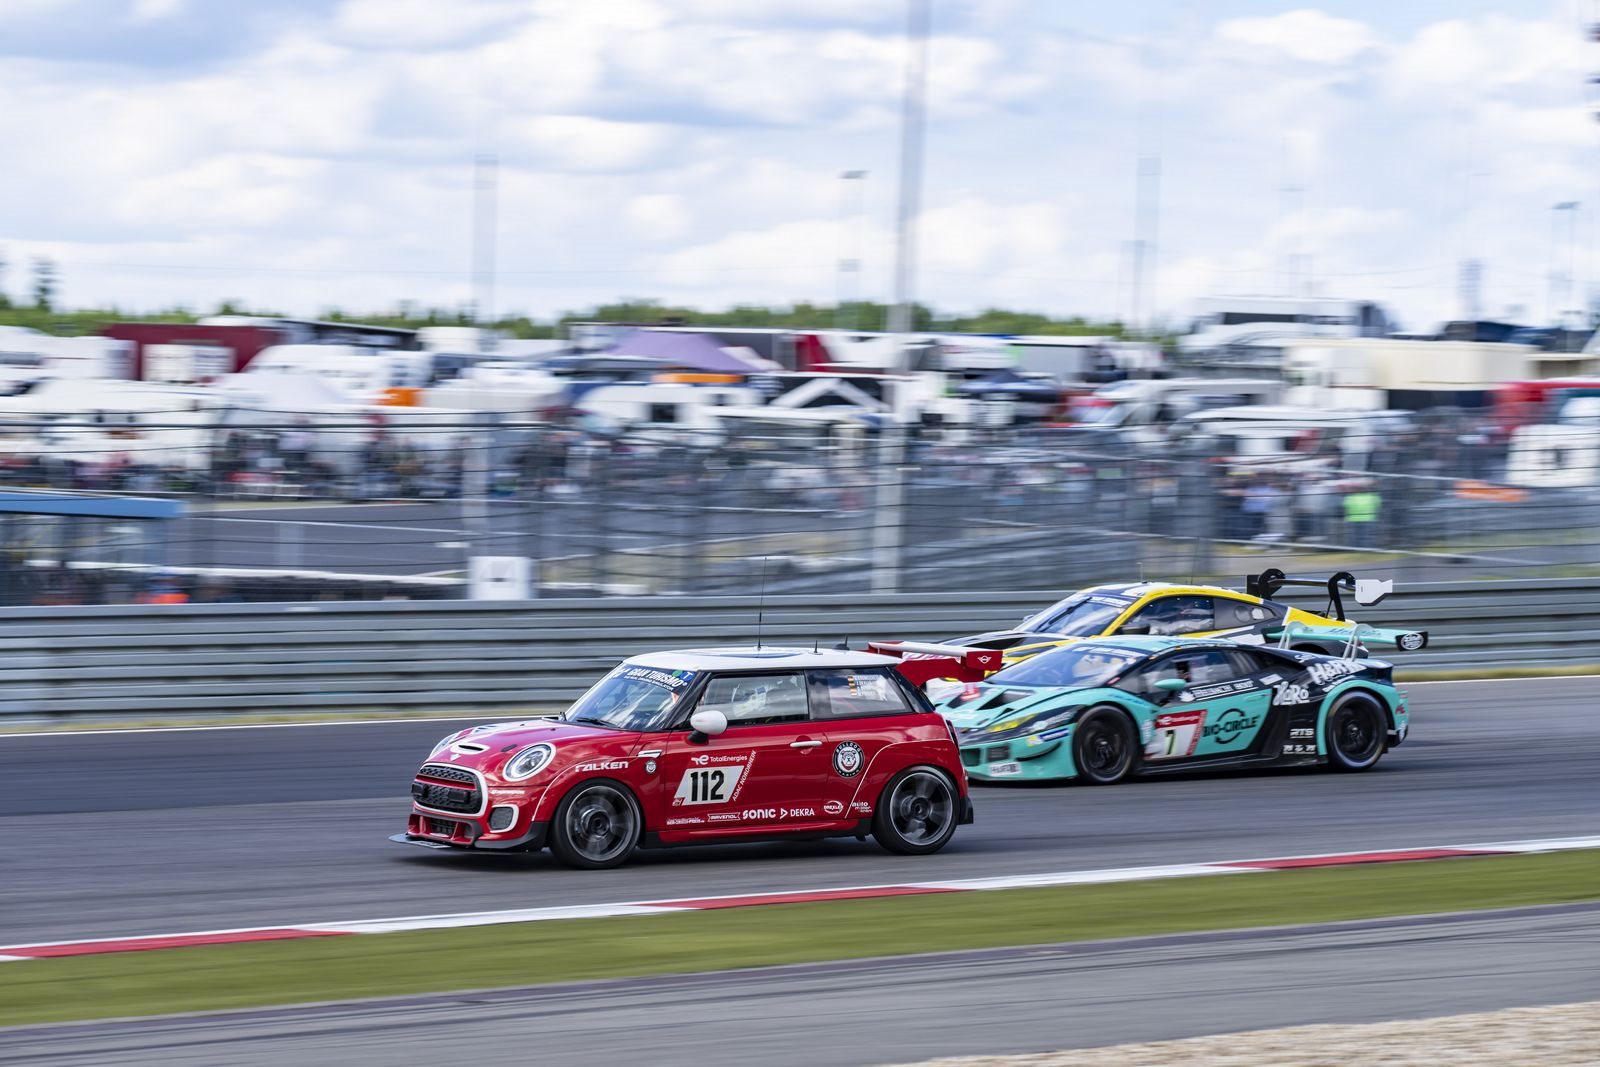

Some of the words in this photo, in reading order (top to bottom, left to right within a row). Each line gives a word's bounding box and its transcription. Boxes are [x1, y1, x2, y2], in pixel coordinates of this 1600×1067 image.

[646, 670, 684, 687] TURISMO
[1202, 715, 1259, 737] BIO-CIRCLE
[1166, 729, 1175, 755] 7
[575, 761, 629, 773] FALKEN
[710, 755, 748, 763] TotalEnergies
[732, 784, 743, 801] ADAC
[740, 749, 757, 785] NORDRHEIN
[690, 770, 725, 801] 112
[742, 803, 777, 820] SONIC
[790, 807, 815, 817] DEKRA
